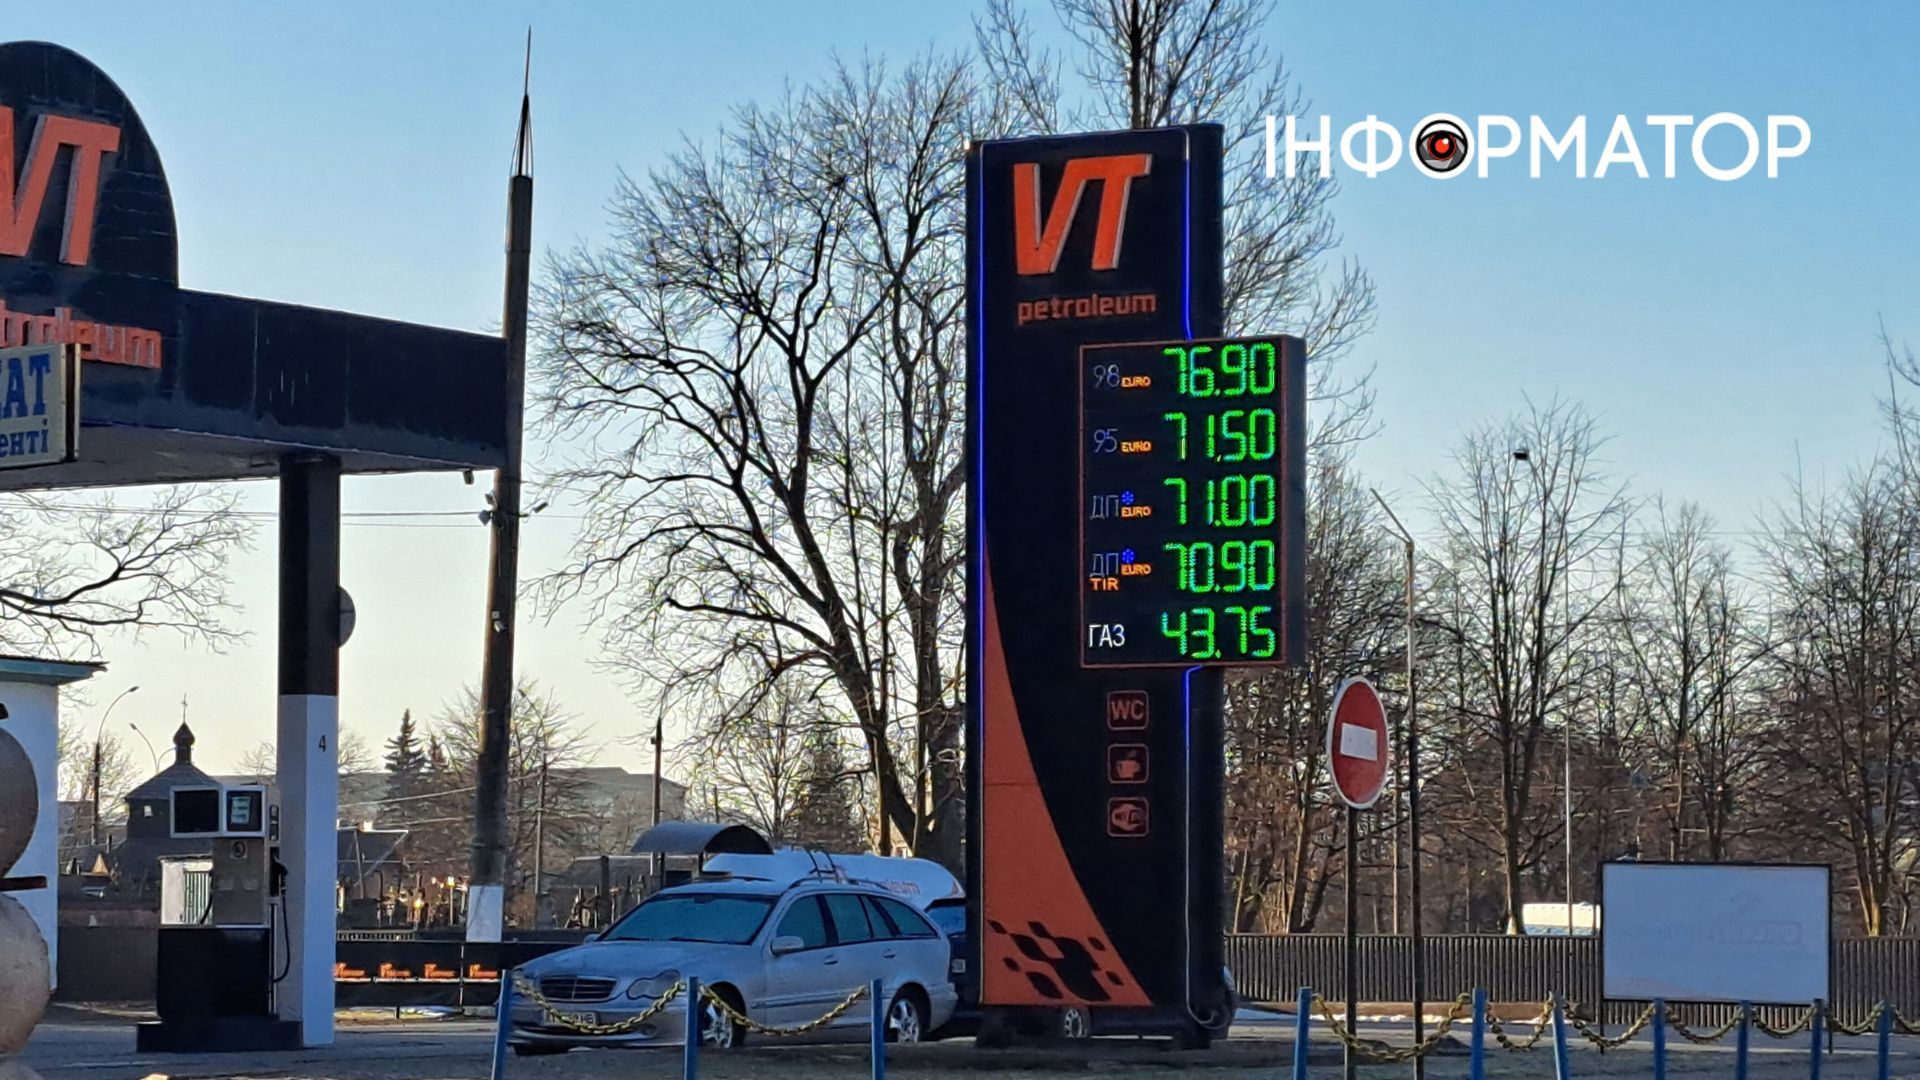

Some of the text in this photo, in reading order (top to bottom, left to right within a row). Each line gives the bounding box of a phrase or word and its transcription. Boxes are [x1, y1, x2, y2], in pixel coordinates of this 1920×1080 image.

[1013, 154, 1153, 275] VT
[1017, 293, 1157, 325] petroleum
[0, 354, 51, 418] АТ
[1093, 364, 1120, 388] 98
[1121, 376, 1152, 387] EURO
[1093, 428, 1118, 453] 95
[1121, 440, 1153, 453] EURO
[1090, 474, 1276, 527] ДП EURO 71.00
[1121, 564, 1152, 576] EURO
[1163, 540, 1276, 593] 70.90
[1089, 578, 1120, 591] TIR
[1088, 606, 1276, 658] ГАЗ 43.75
[1110, 699, 1145, 720] WC
[318, 734, 326, 752] 4
